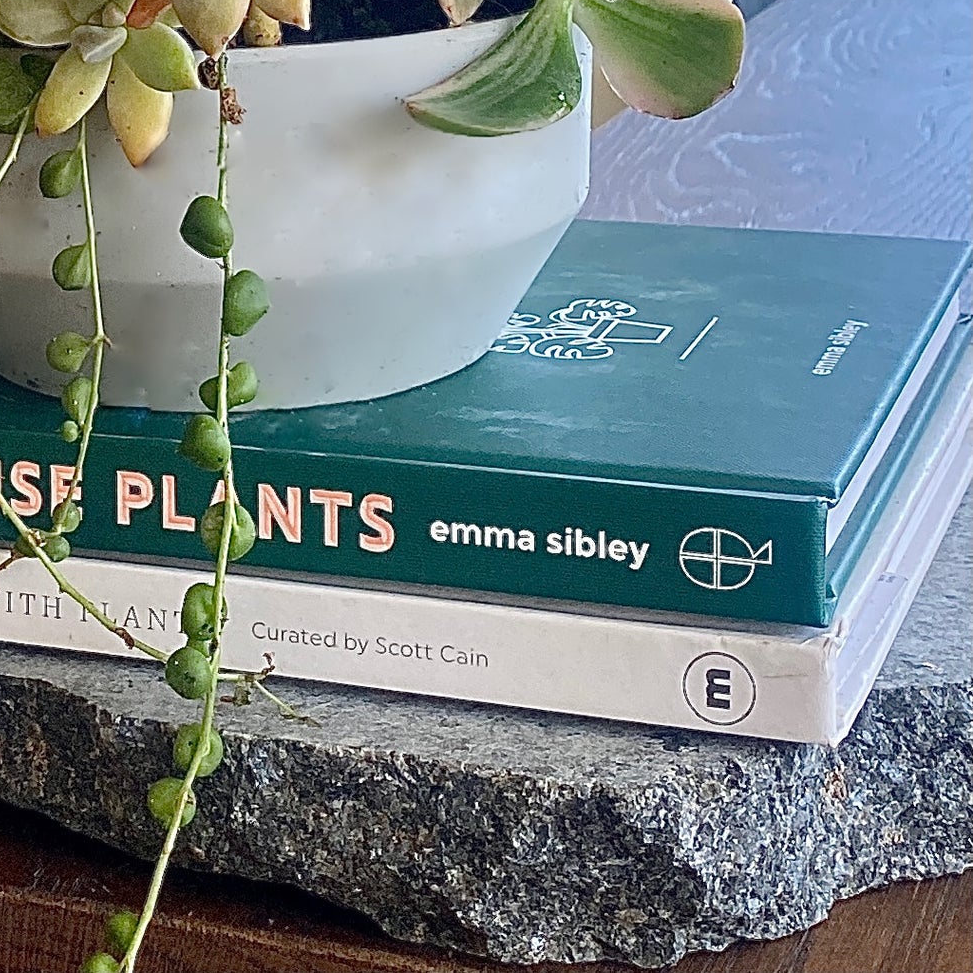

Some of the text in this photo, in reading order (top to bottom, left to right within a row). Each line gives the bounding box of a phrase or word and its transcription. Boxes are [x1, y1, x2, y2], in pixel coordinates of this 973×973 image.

[812, 319, 869, 375] emma sibley
[116, 470, 395, 553] PLNTS
[430, 520, 650, 570] emma sibley
[251, 621, 489, 668] Curated by Scott Cain
